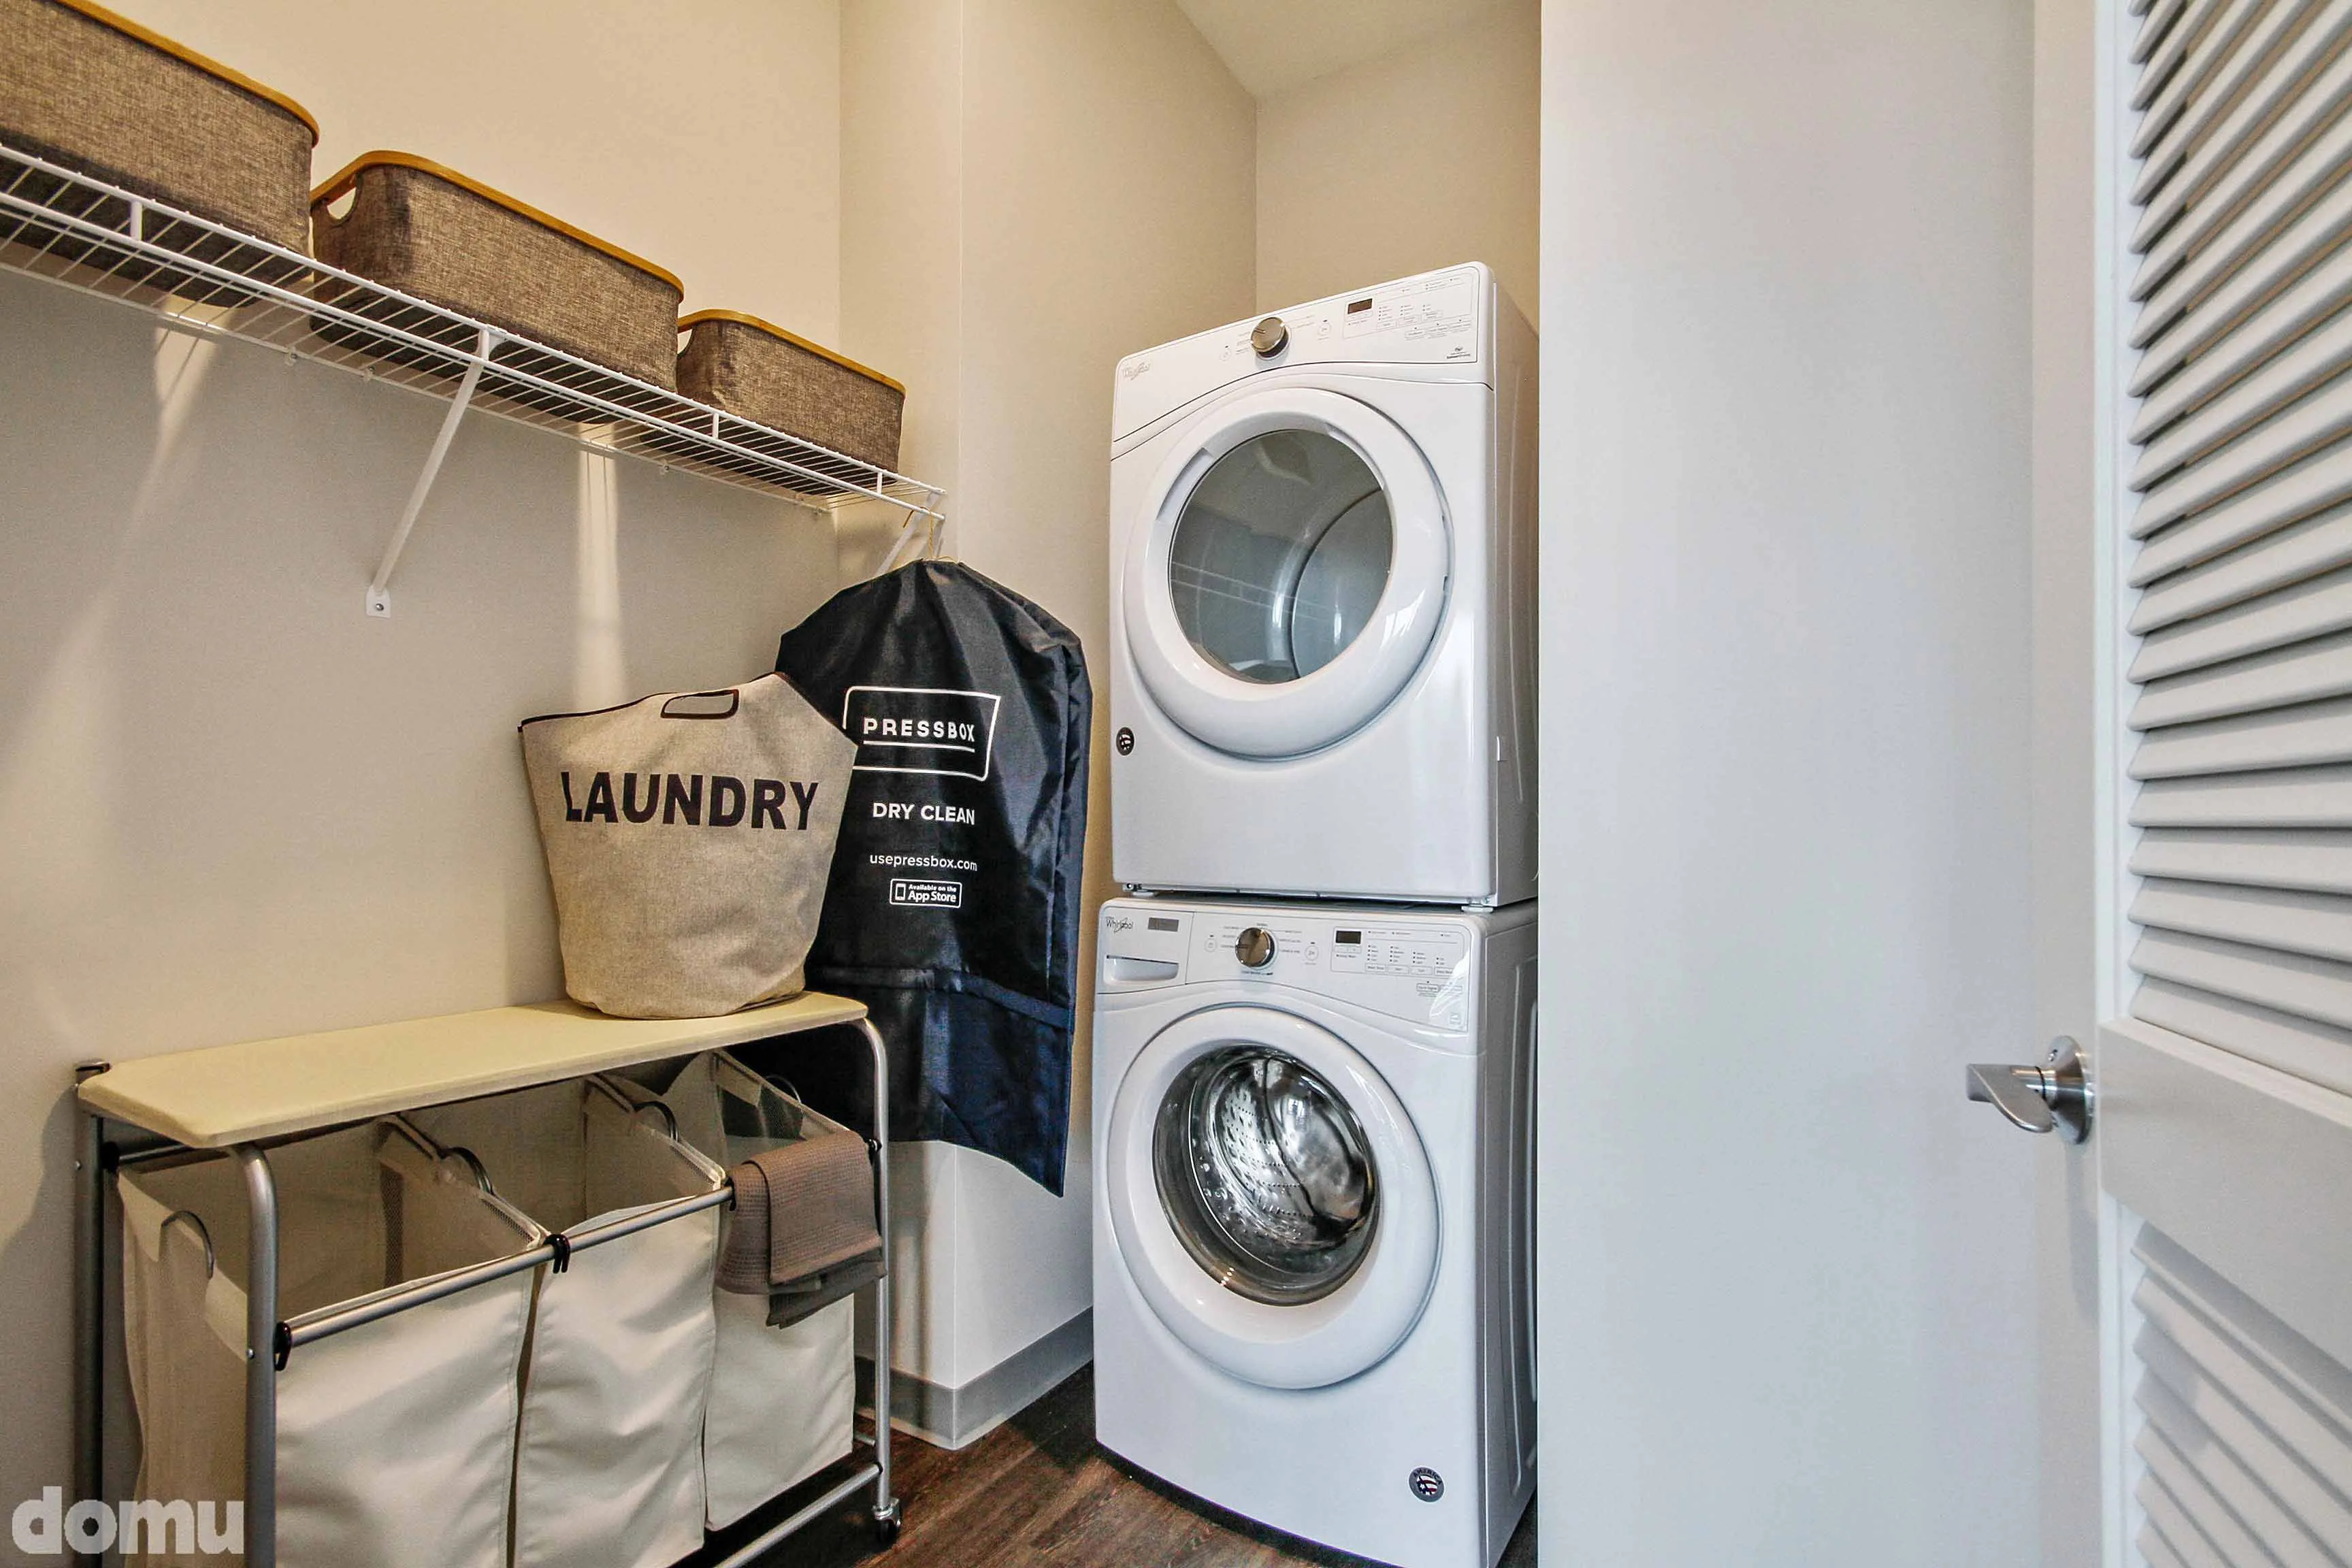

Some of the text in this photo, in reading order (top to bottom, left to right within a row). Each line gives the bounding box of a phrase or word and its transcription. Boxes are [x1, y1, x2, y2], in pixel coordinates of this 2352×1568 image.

[863, 717, 975, 742] PRESSBOX
[560, 771, 819, 830] LAUNDRY
[872, 802, 975, 826] DRY CLEAN
[870, 854, 977, 872] usepressbox.com
[907, 891, 957, 903] App Store
[1105, 917, 1134, 932] Whirlpool
